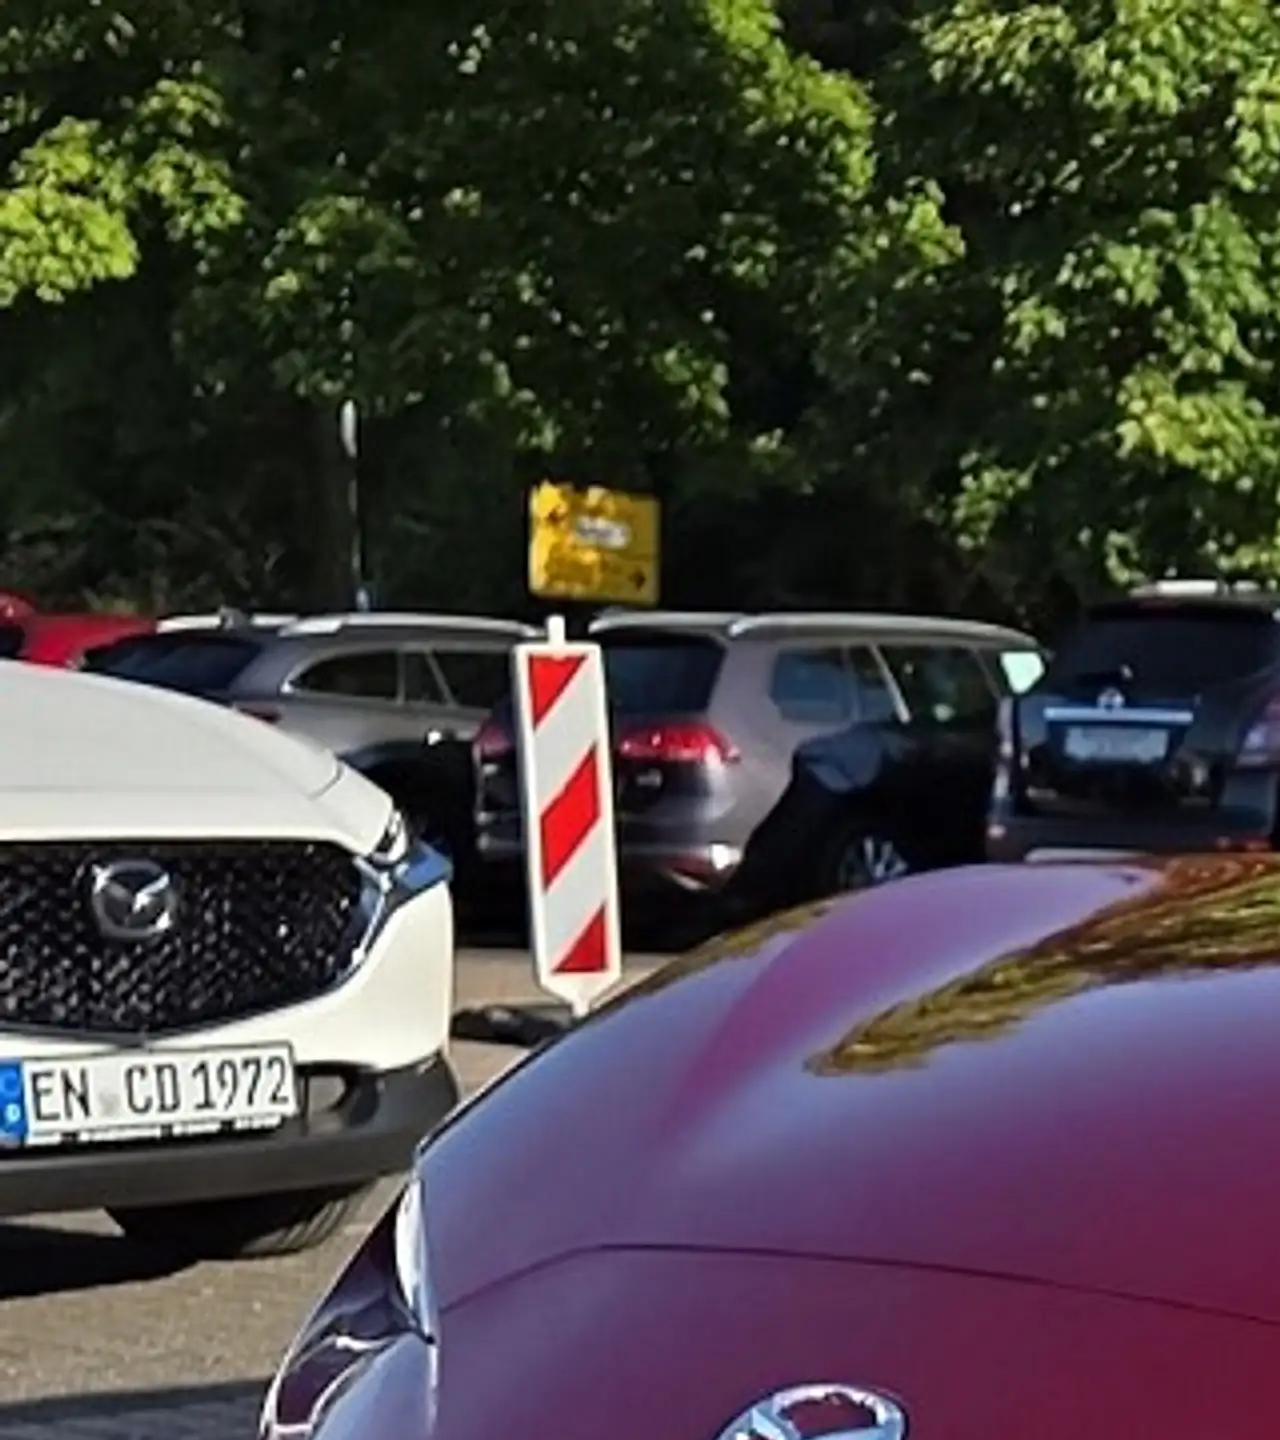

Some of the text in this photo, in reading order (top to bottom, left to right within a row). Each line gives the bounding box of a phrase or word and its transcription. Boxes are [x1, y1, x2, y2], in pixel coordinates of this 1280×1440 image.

[31, 1055, 289, 1122] EN CD 1972
